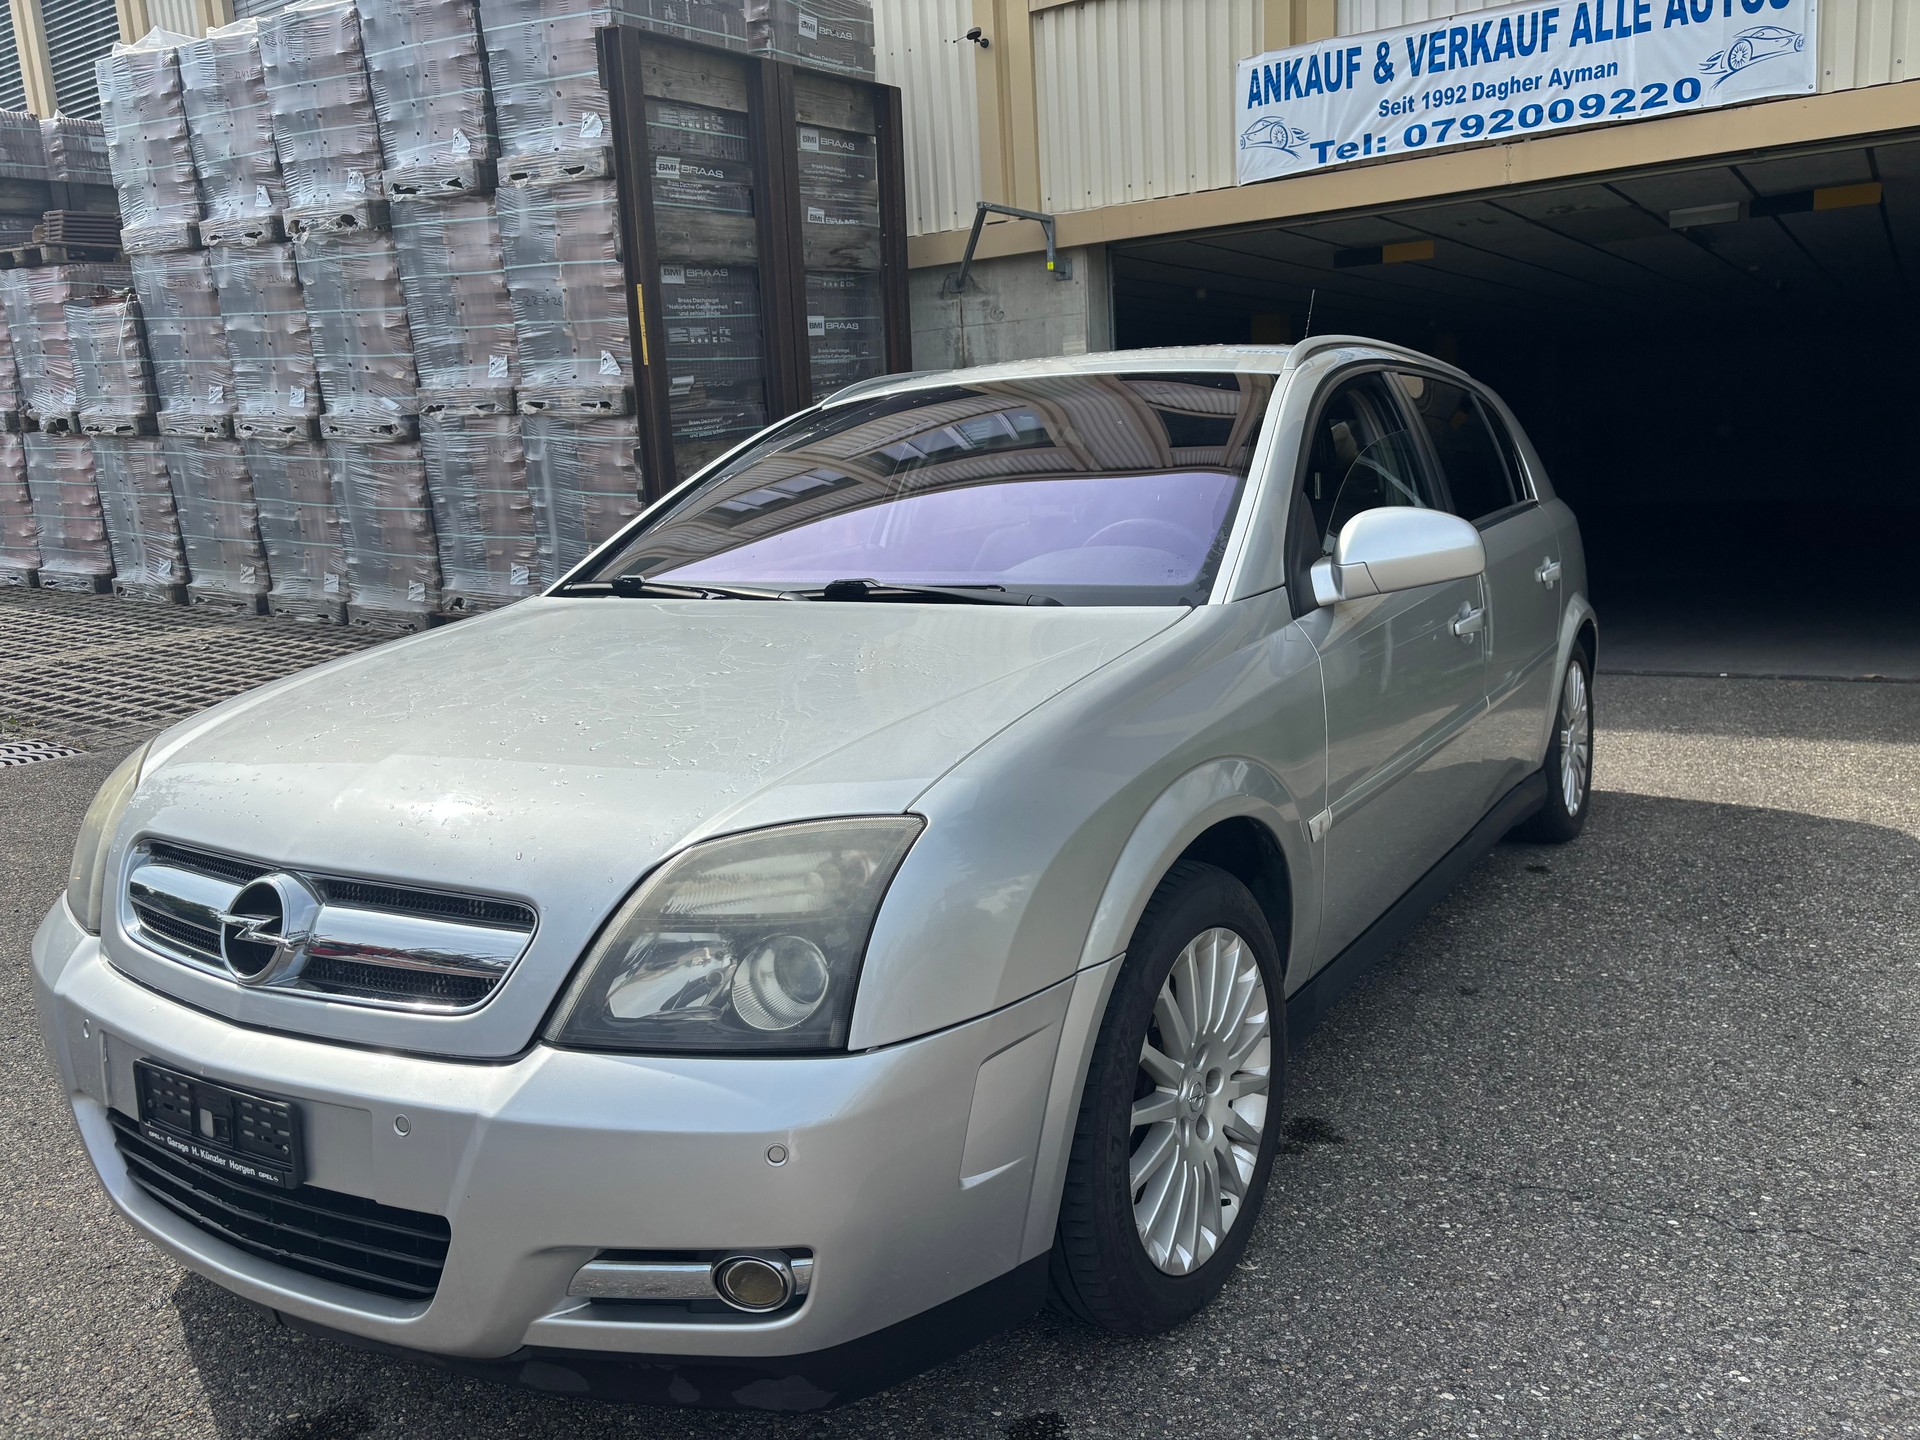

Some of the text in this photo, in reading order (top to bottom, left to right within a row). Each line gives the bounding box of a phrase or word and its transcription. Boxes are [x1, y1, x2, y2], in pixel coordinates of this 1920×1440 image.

[1247, 46, 1362, 109] ANKAUF
[1373, 41, 1395, 84] &
[1406, 7, 1560, 77] VERKAUF
[1569, 0, 1652, 47] ALLE
[1378, 61, 1618, 117] Seit 1992 Dagher Ayman
[1310, 77, 1701, 164] Tel: 0792009220
[802, 135, 855, 151] BMI BRAAS
[658, 163, 724, 179] BMI BRAAS
[663, 268, 729, 277] BMI BRAAS
[825, 322, 859, 330] BRAAS
[166, 1136, 189, 1153] Garage
[200, 1149, 226, 1166] Künzler
[229, 1159, 255, 1176] Horgen
